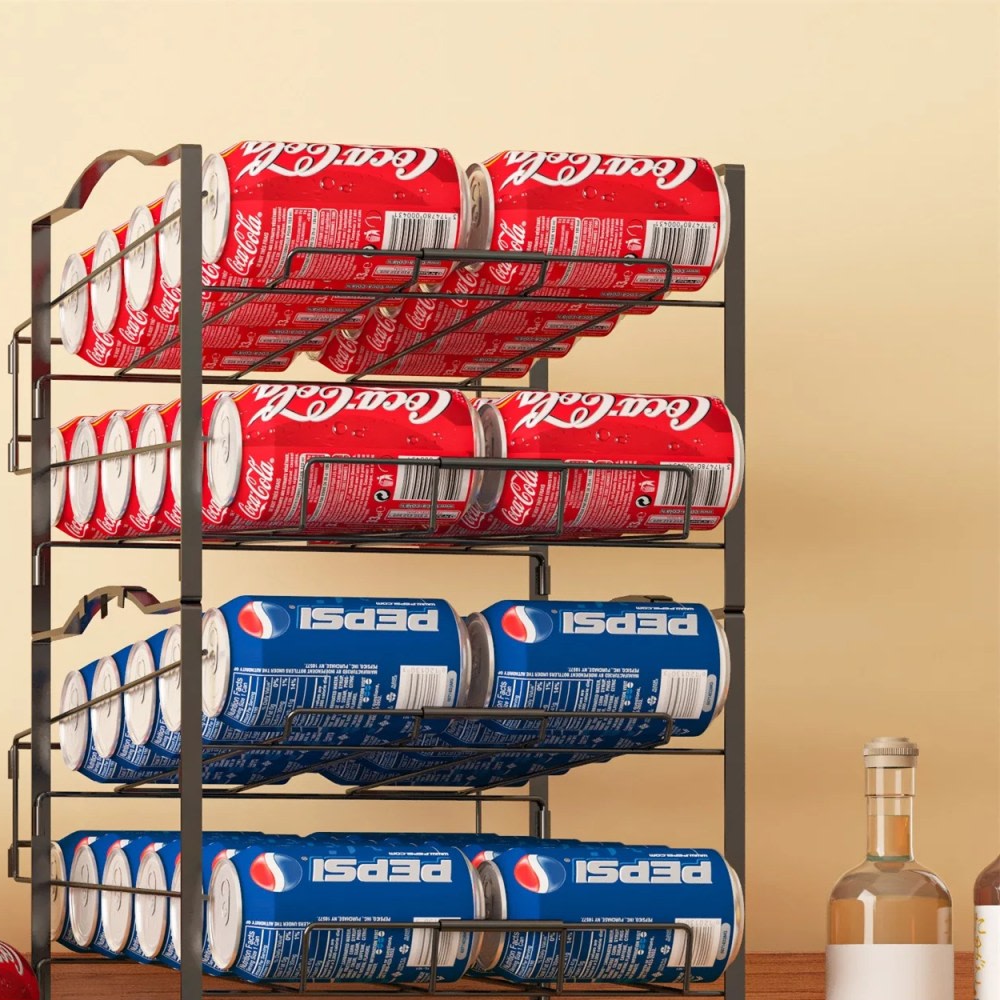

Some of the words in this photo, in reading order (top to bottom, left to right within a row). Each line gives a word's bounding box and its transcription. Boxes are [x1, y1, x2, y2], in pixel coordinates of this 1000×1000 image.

[235, 141, 438, 180] Coca-Cola
[499, 151, 696, 190] Coca-Cola
[226, 209, 263, 276] Coca-Cola
[247, 384, 451, 424] Coca-Cola
[512, 391, 710, 431] Coca-Cola
[238, 456, 274, 520] Coca-Cola
[300, 607, 439, 632] PEPSI
[563, 611, 699, 636] PEPSI
[233, 678, 243, 696] Facts
[273, 678, 279, 688] 0%
[312, 858, 452, 883] PEPSI
[576, 860, 712, 884] PEPSI
[245, 931, 255, 949] Facts
